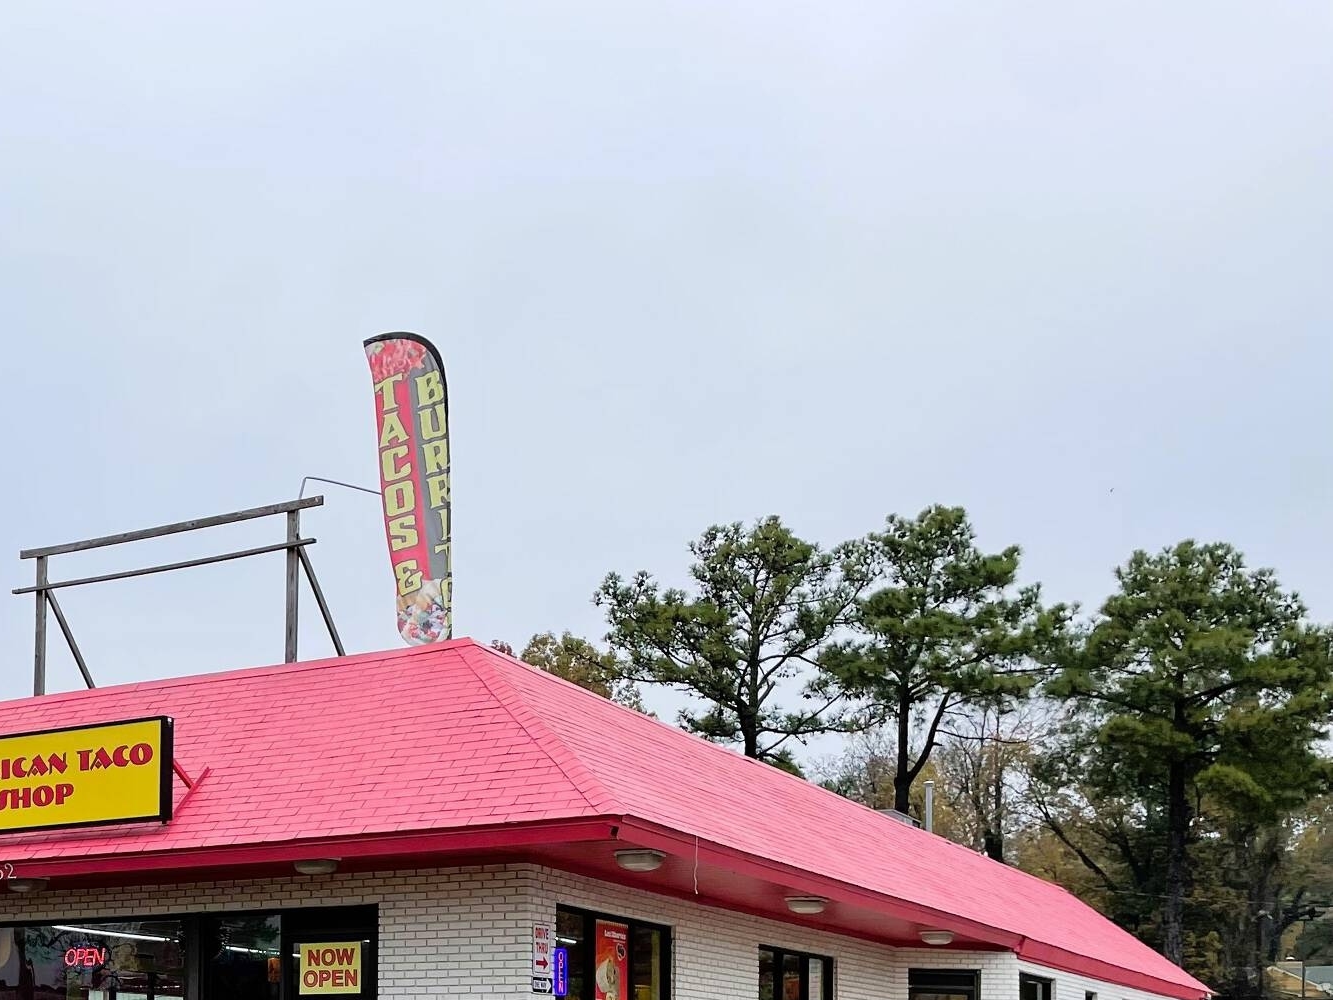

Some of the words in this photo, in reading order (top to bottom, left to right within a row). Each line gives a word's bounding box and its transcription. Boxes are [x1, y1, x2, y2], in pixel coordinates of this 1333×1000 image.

[374, 373, 419, 551] TACOS
[414, 369, 452, 639] BURRIT
[395, 559, 423, 597] &
[76, 743, 154, 772] TACO
[64, 947, 106, 966] OPEN
[307, 948, 355, 966] NOW
[535, 941, 548, 954] THRU
[303, 969, 358, 987] OPEN
